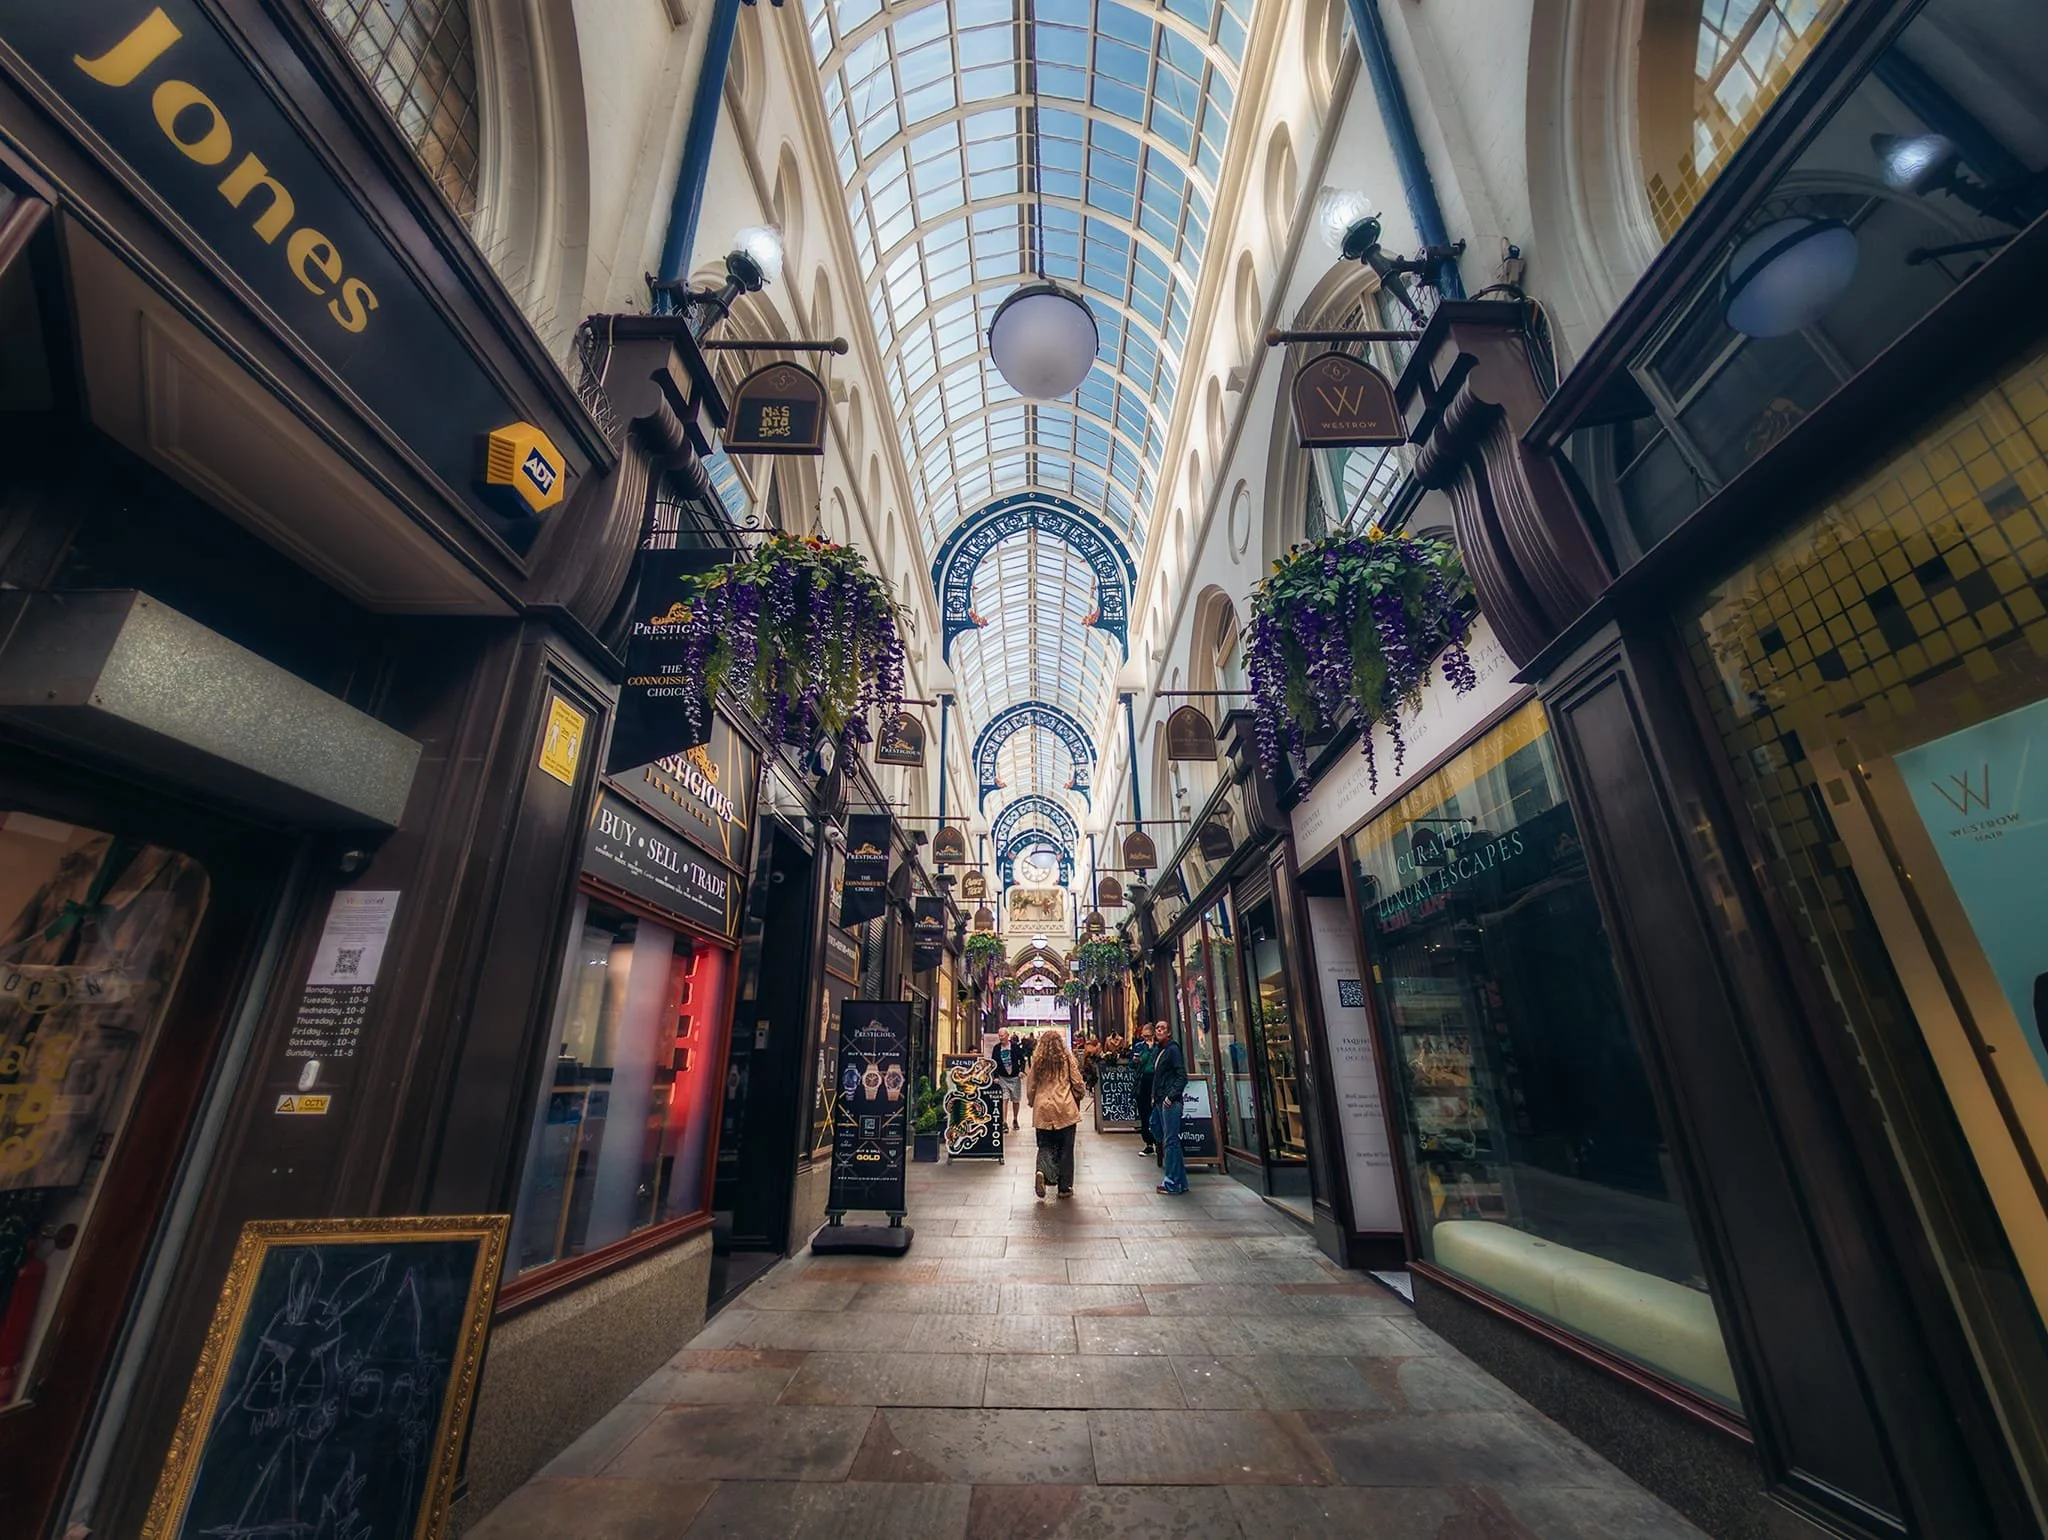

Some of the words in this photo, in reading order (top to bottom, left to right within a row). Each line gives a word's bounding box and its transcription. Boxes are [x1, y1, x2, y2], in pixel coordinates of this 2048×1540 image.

[73, 6, 378, 333] Jones
[1333, 366, 1340, 375] 6
[780, 375, 786, 385] 5
[1321, 421, 1377, 429] WESTROW
[523, 455, 556, 490] ADT
[633, 622, 696, 636] PRESTIG
[660, 665, 683, 673] THE
[627, 676, 690, 685] CONNOISSE
[655, 754, 734, 822] STIGIOUS
[1950, 813, 2020, 838] WESTROW
[1397, 817, 1473, 875] CURATED
[598, 809, 636, 847] BUY
[647, 838, 680, 874] SELL
[690, 862, 727, 899] TRADE
[1377, 875, 1433, 919] LUXURY
[1439, 831, 1525, 890] ESCAPES
[1101, 1072, 1115, 1081] WE
[1117, 1072, 1135, 1081] MAK
[1102, 1082, 1134, 1093] CUSTO
[304, 1099, 326, 1107] CCTV
[992, 1100, 1000, 1146] TATTOO
